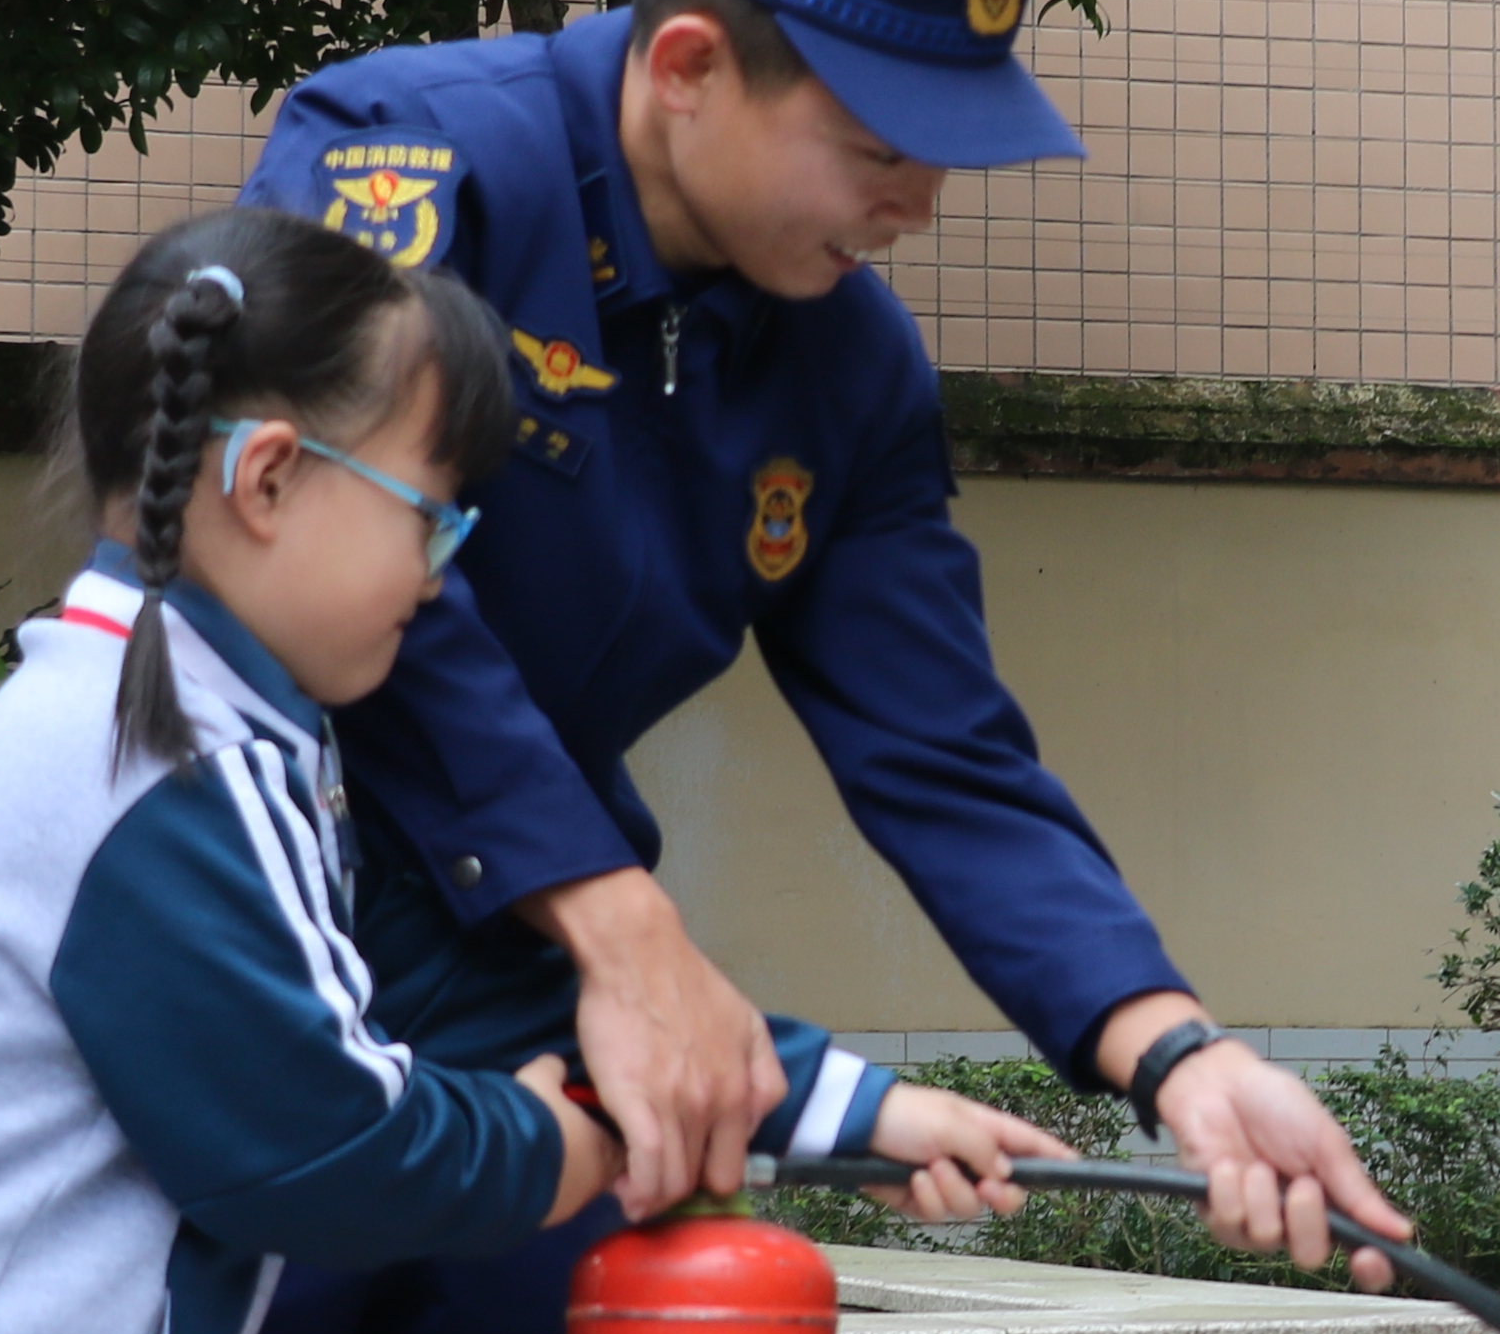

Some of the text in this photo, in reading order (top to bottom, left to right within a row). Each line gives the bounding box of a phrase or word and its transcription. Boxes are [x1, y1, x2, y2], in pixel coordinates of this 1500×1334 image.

[324, 145, 453, 172] 中国消防救援
